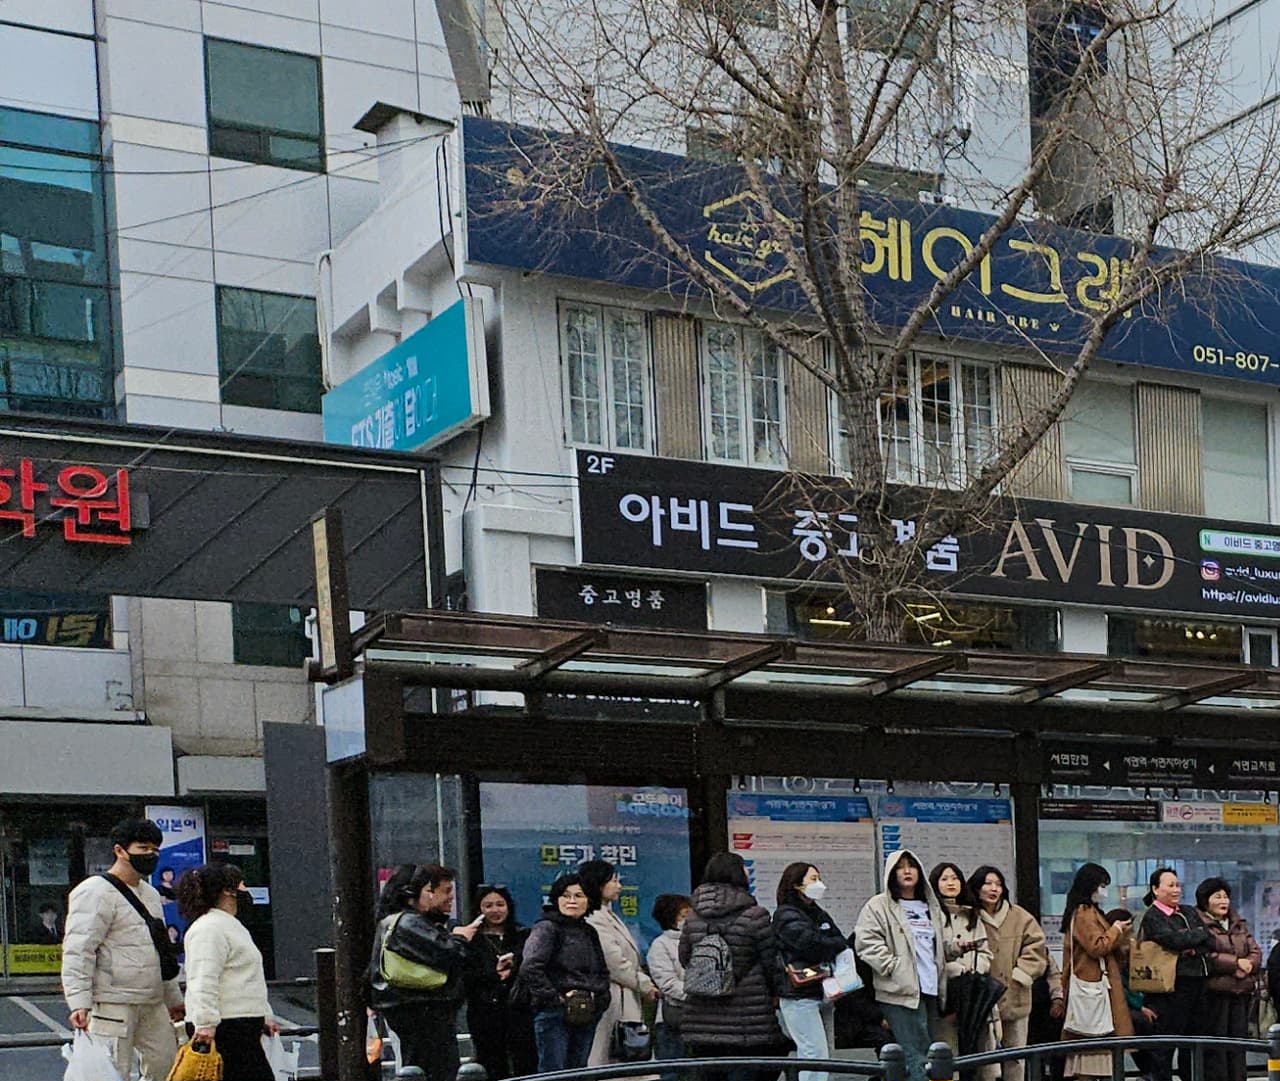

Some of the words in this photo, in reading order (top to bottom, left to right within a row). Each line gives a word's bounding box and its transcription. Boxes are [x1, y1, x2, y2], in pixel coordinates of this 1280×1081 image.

[586, 454, 616, 475] 2F
[619, 492, 760, 552] 아비드
[991, 518, 1177, 591] AVID
[577, 583, 666, 611] 중고명품
[156, 817, 198, 834] 일본어
[541, 843, 596, 867] 모두가
